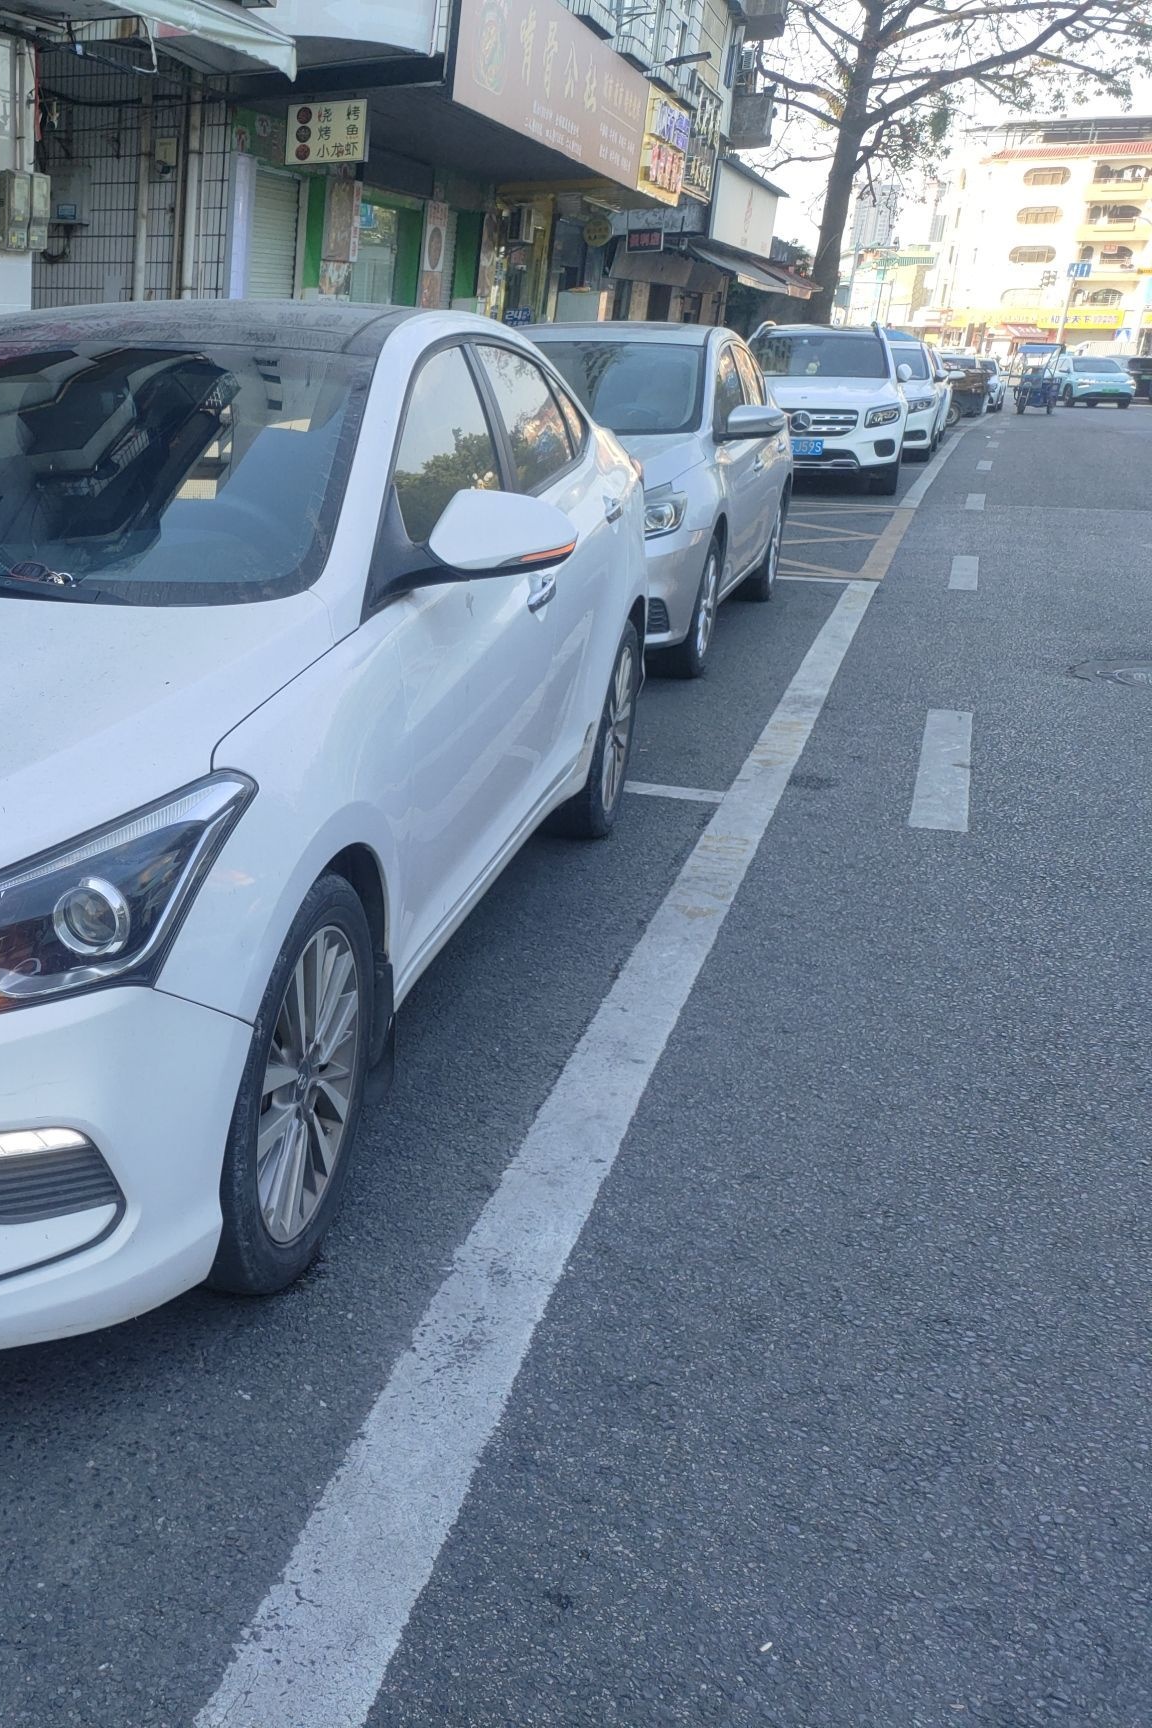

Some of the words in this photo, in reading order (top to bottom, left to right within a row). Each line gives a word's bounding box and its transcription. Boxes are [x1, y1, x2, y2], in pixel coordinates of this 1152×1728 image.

[317, 124, 359, 141] 烤鱼
[316, 142, 359, 158] 小龙虾
